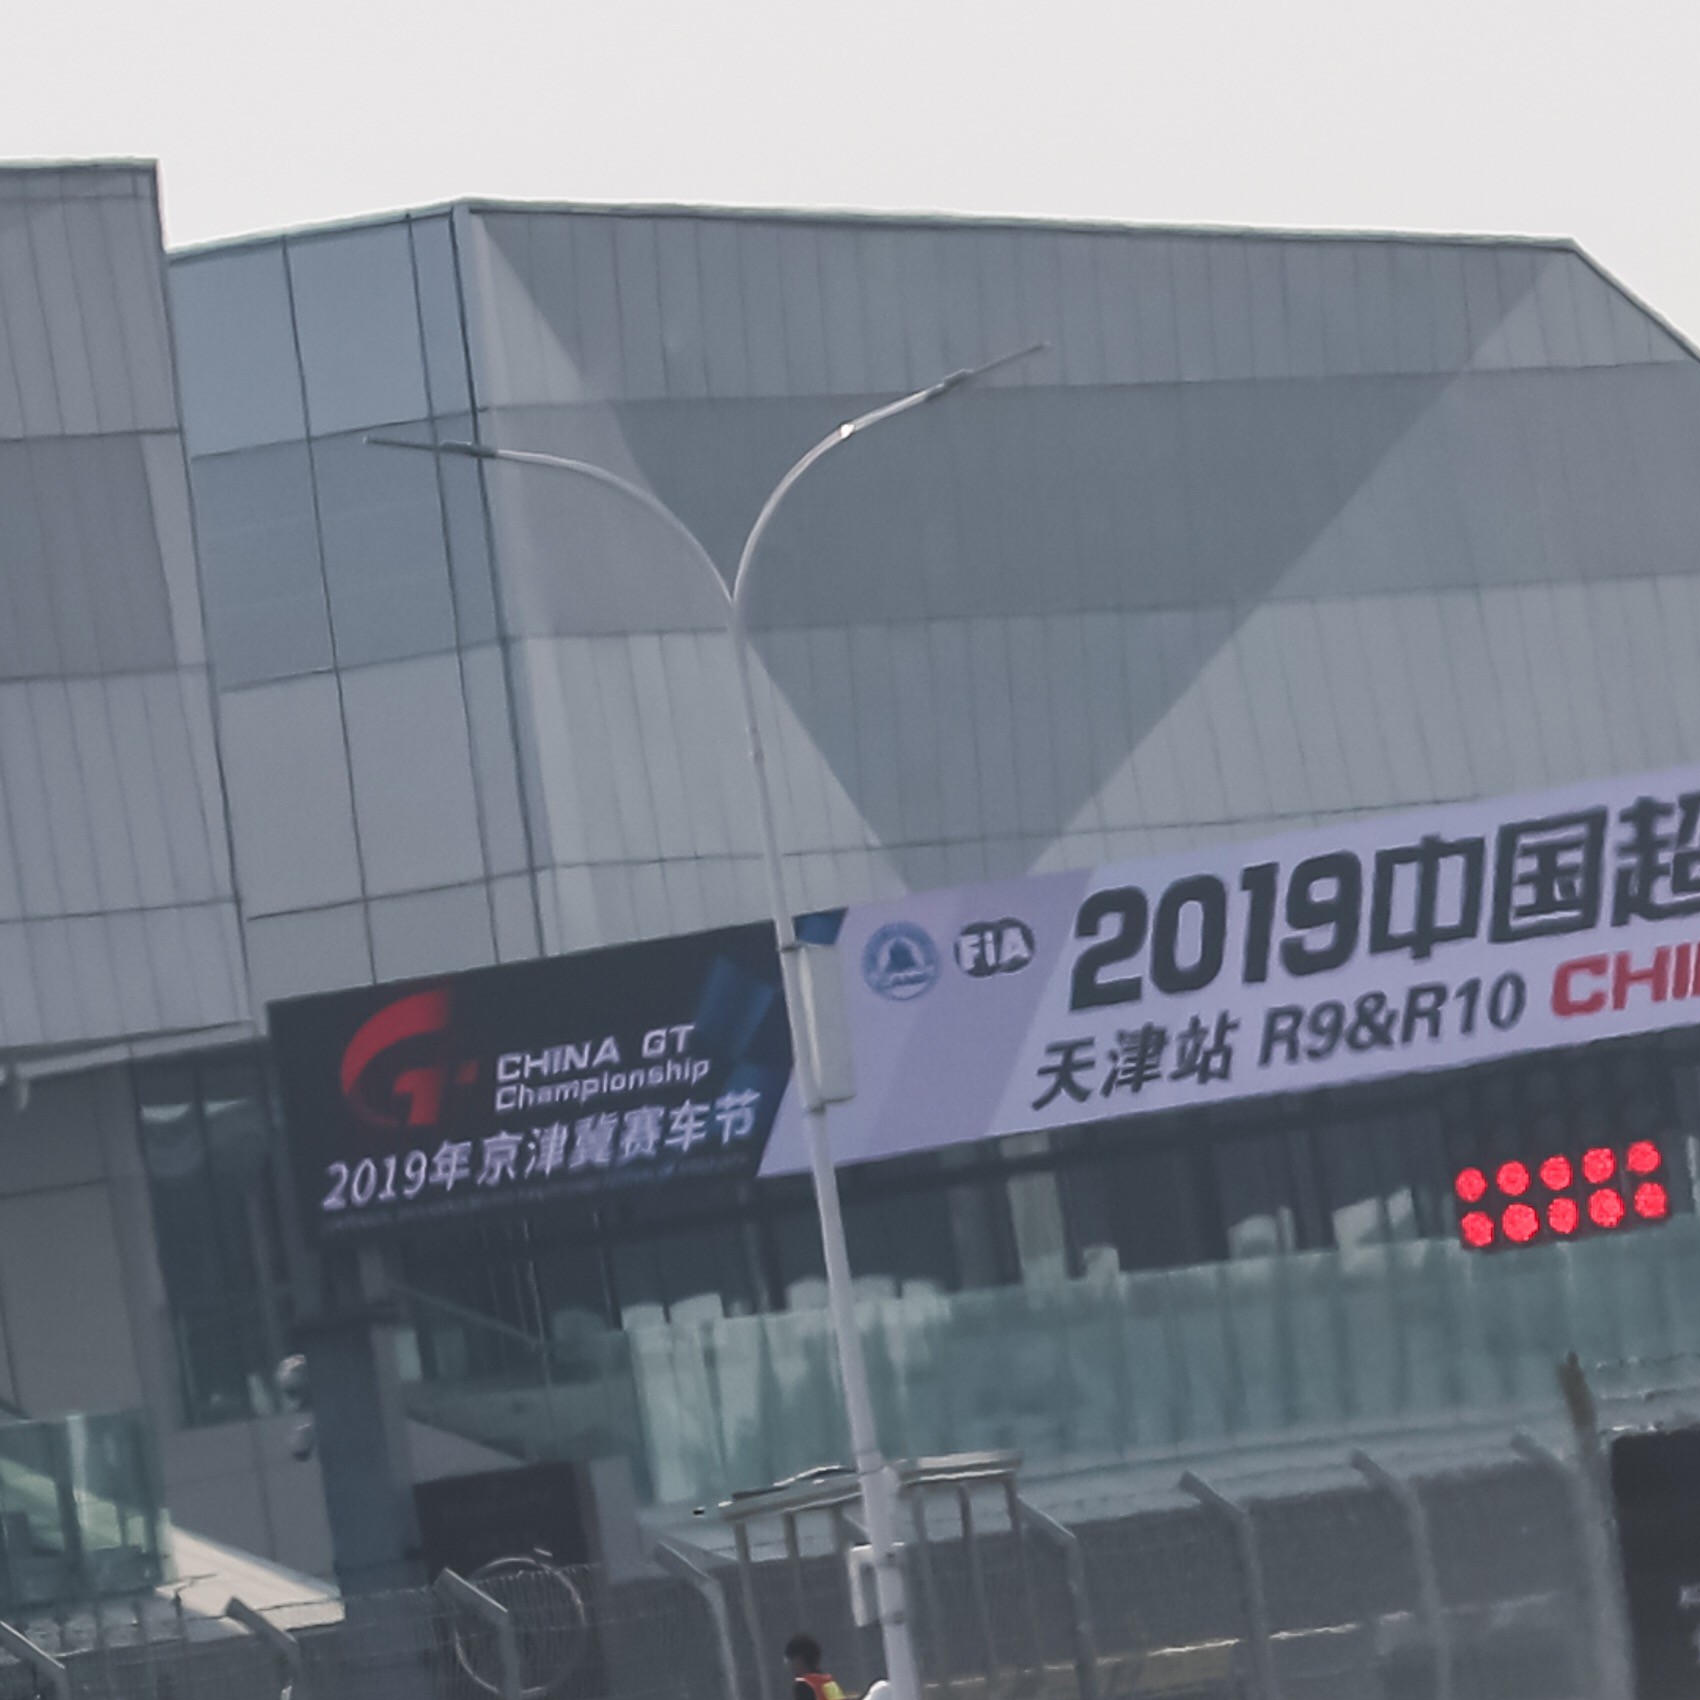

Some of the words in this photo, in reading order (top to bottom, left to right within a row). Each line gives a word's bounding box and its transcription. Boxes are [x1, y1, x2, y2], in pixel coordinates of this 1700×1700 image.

[494, 1056, 711, 1112] Championship
[496, 1041, 620, 1083] CHINA
[641, 1024, 697, 1060] GT
[1031, 1009, 1240, 1111] 天津站
[1256, 970, 1528, 1069] R9&R10
[321, 1087, 763, 1213] 2019年京津冀赛车节
